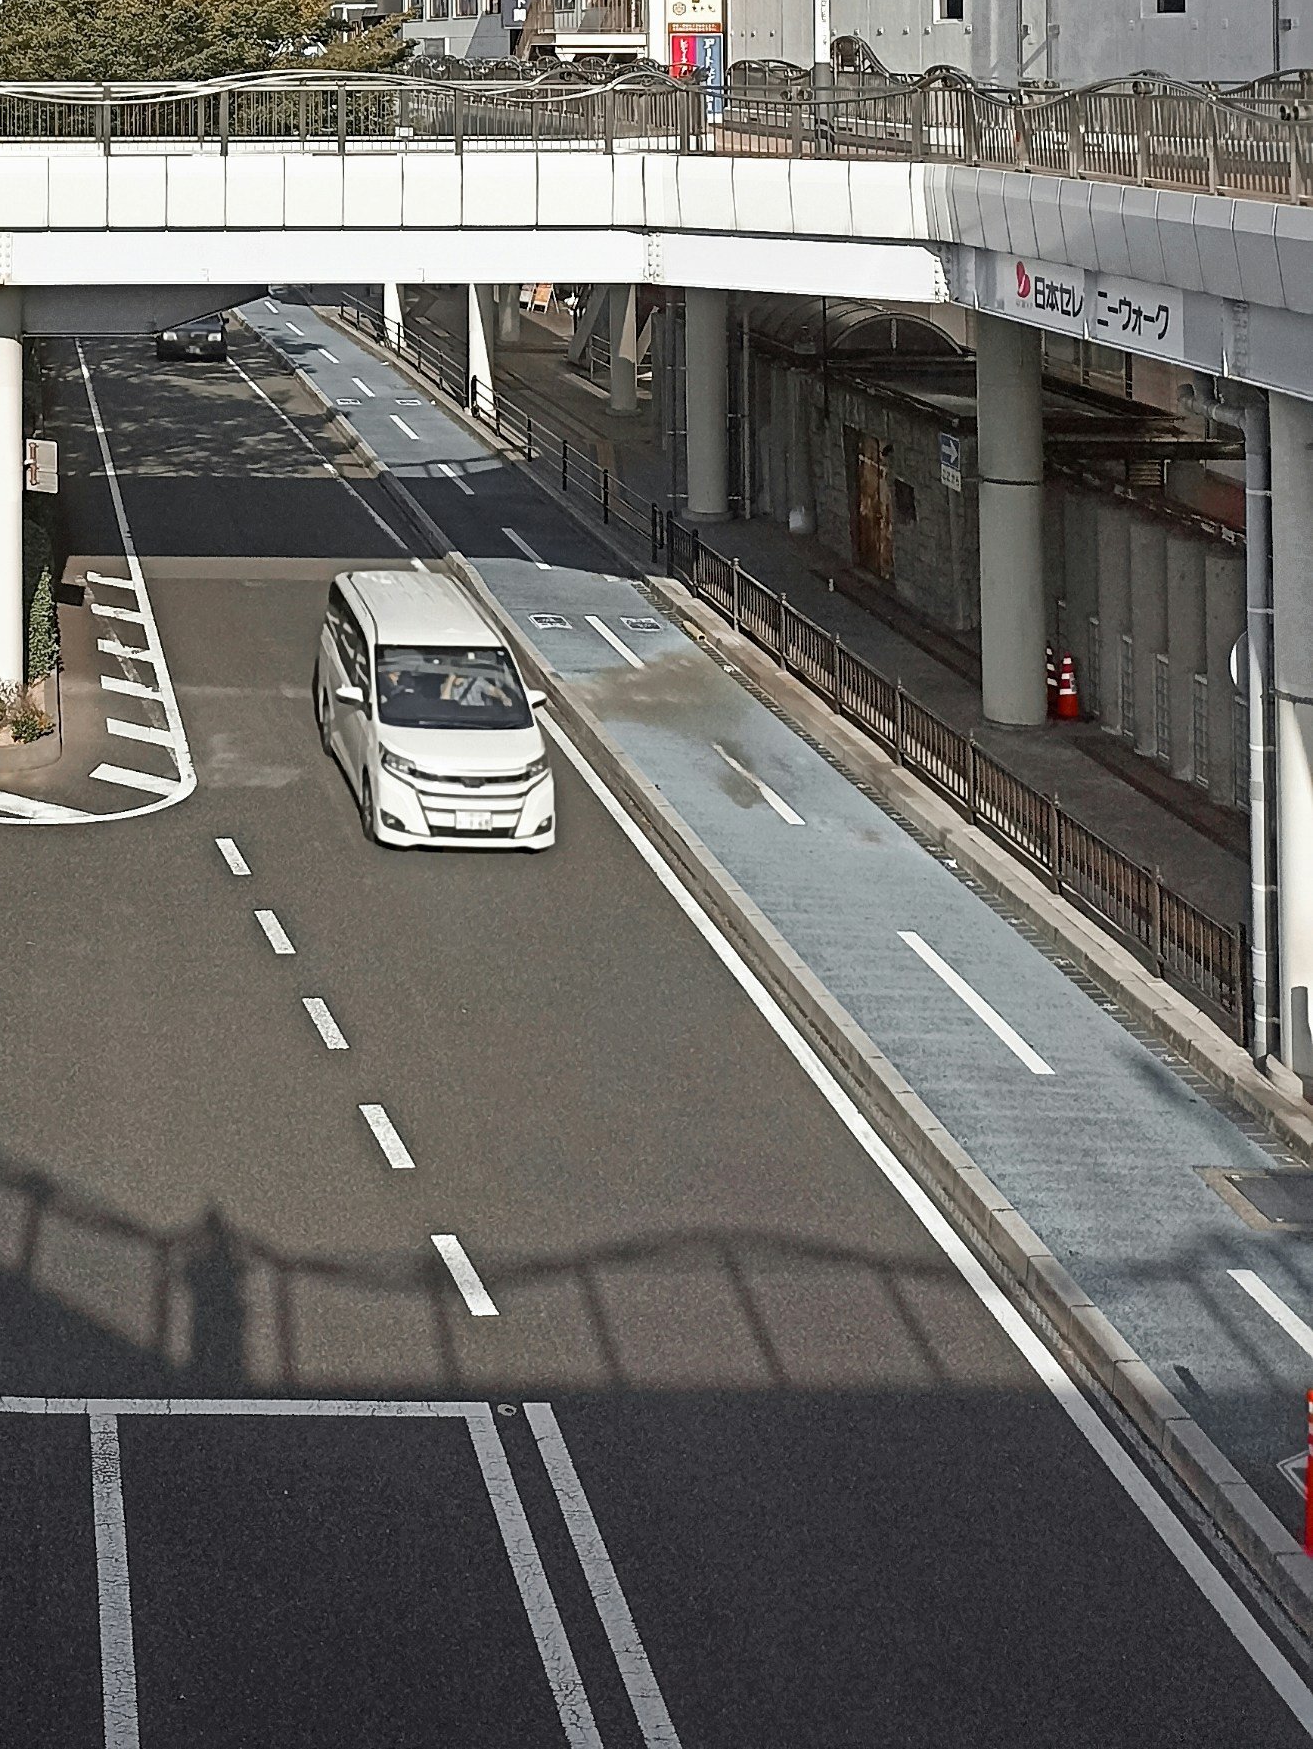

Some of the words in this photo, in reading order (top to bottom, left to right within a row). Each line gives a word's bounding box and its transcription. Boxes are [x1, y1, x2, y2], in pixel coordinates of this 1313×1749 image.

[1034, 275, 1170, 340] 日本セレニーウォーク
